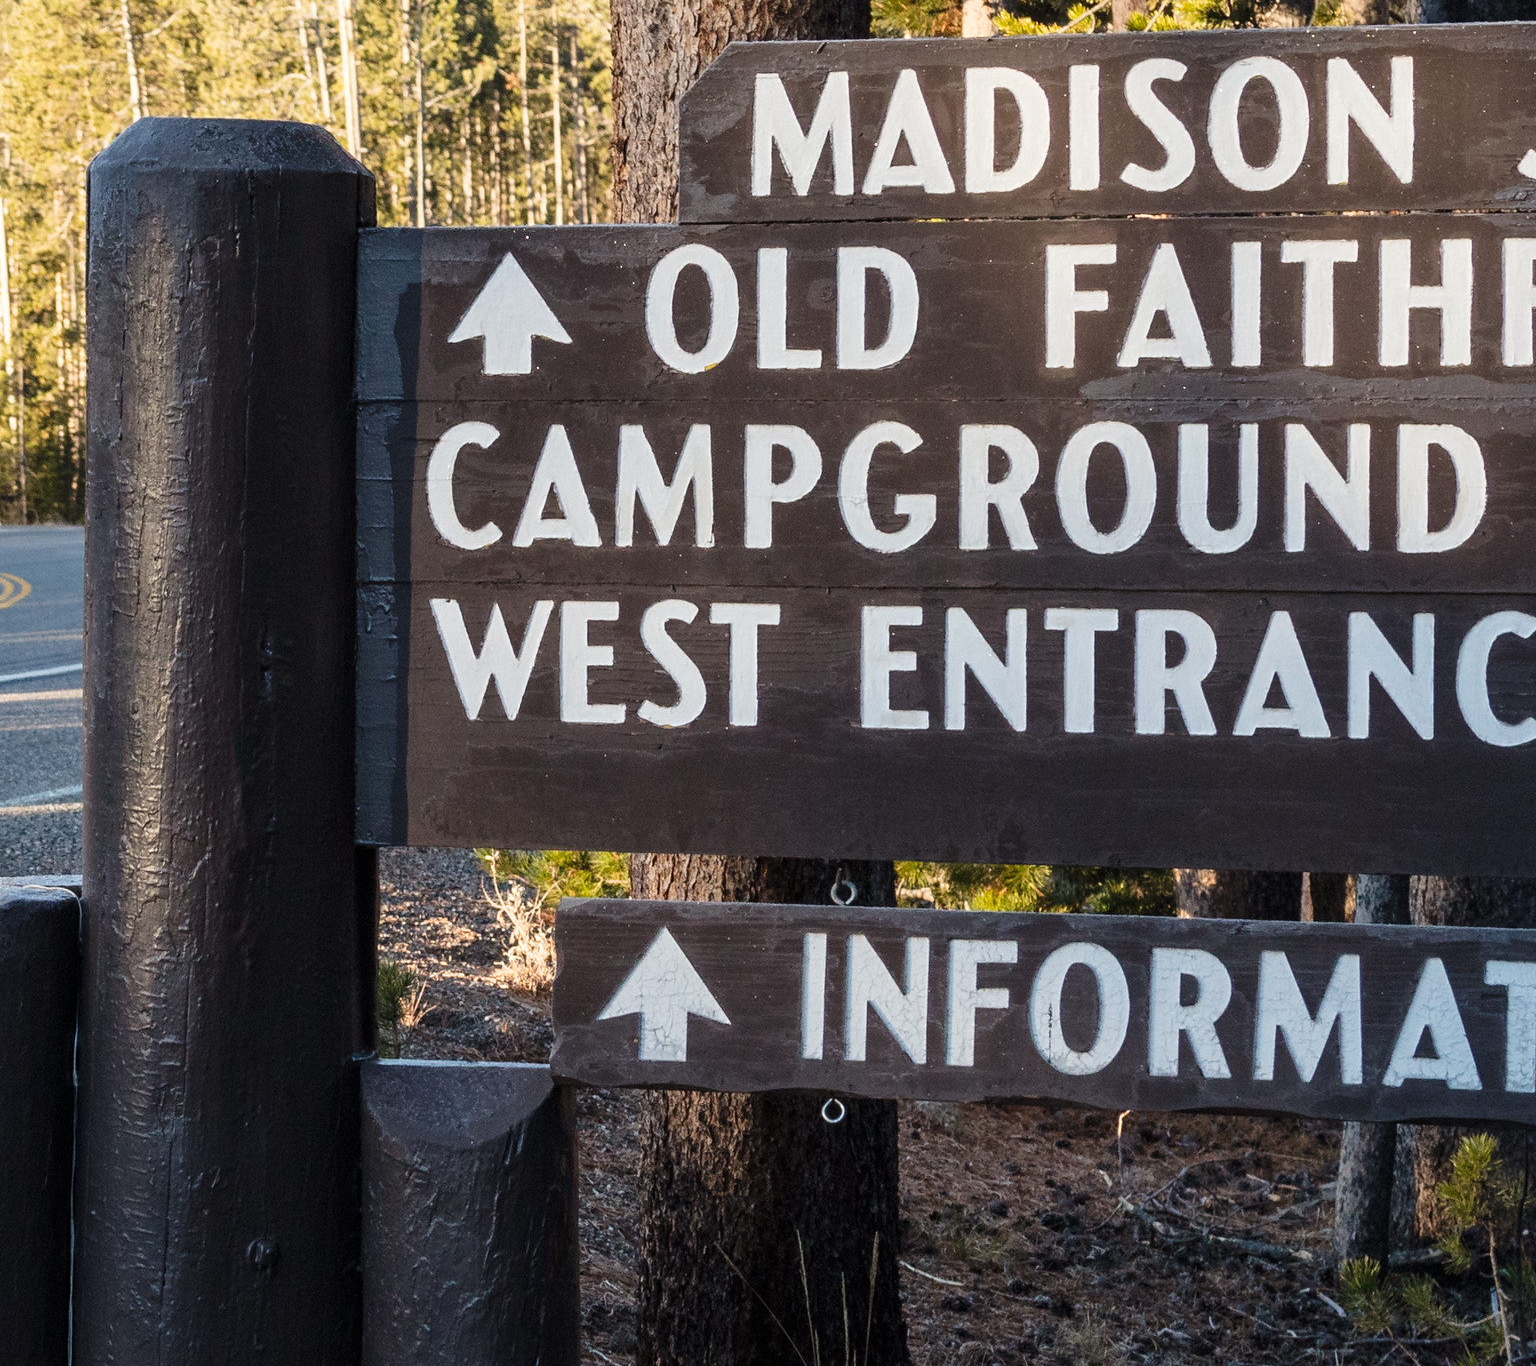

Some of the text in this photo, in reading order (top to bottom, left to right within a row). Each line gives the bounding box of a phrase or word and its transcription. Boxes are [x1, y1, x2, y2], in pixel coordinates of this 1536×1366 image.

[751, 54, 1415, 197] MADISON
[645, 243, 919, 375] OLD
[426, 420, 1488, 554] CAMPGROUND
[430, 598, 781, 729] WEST
